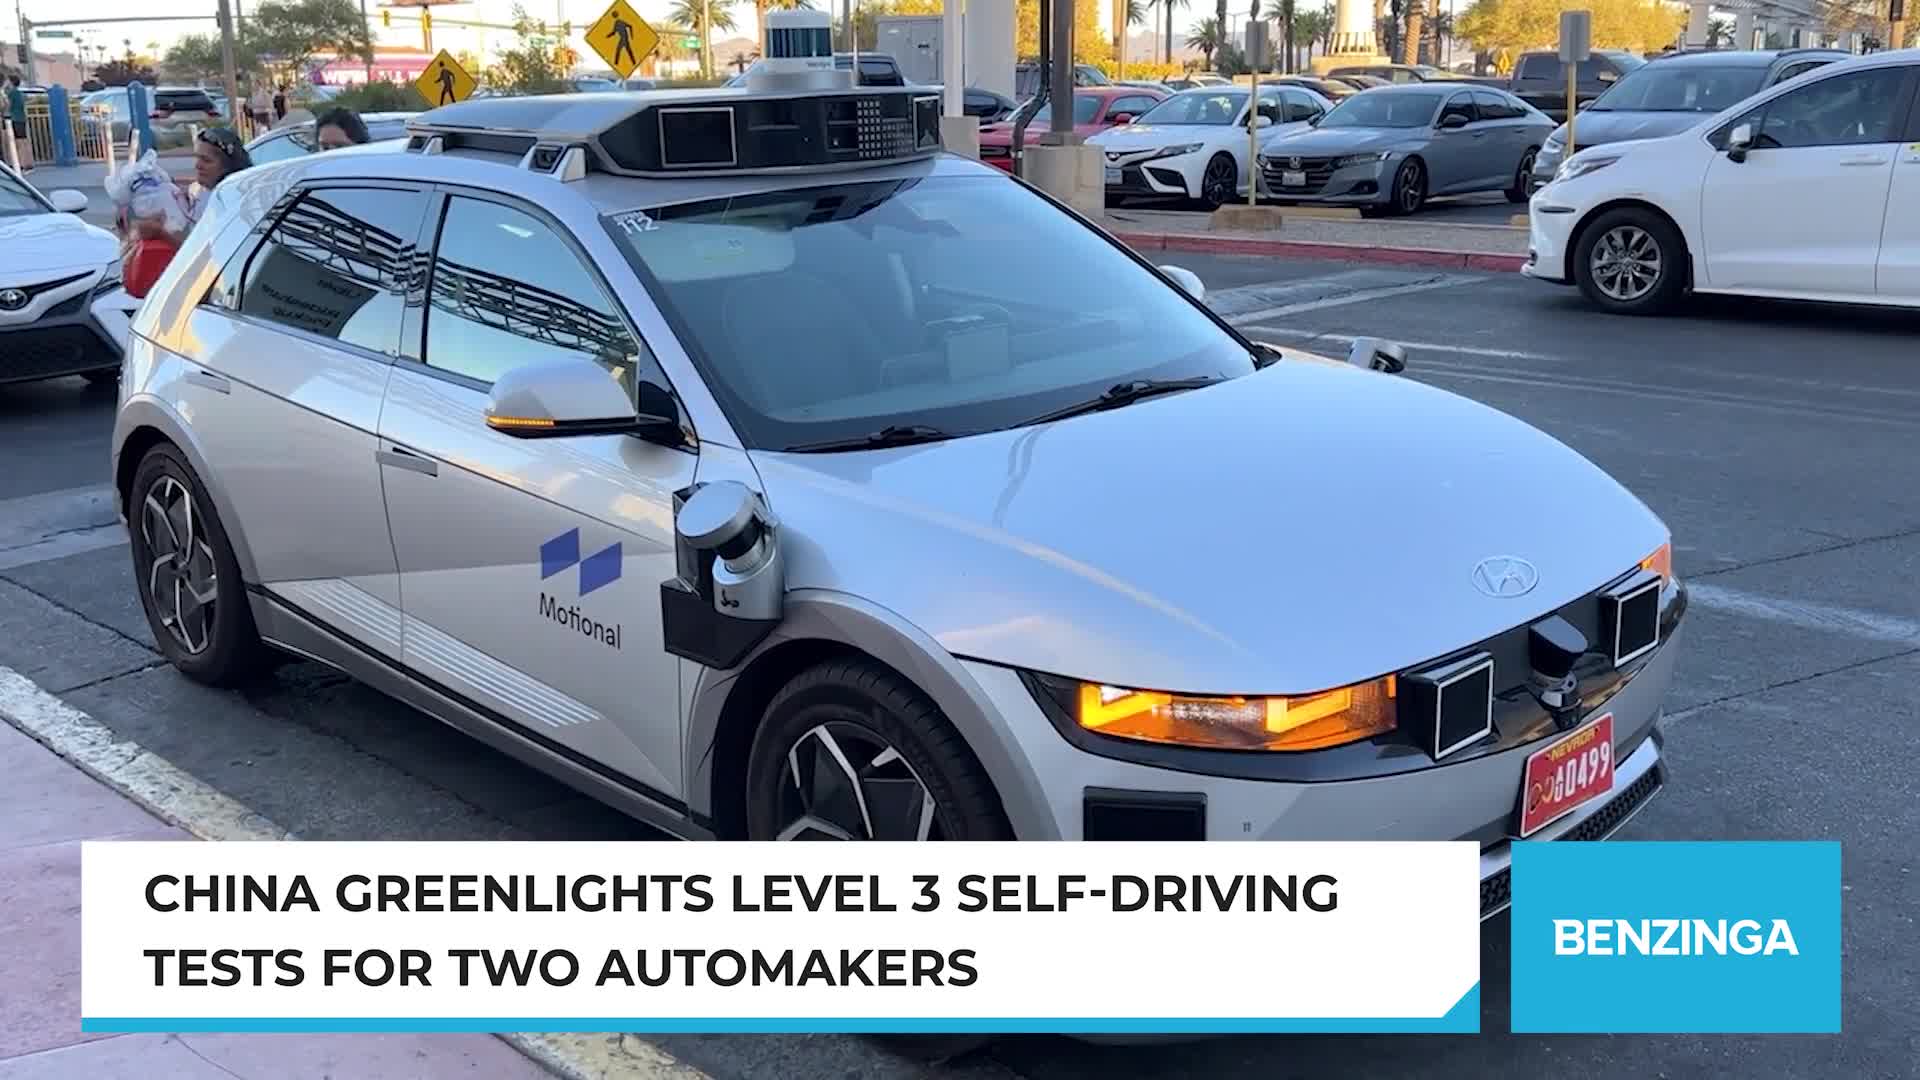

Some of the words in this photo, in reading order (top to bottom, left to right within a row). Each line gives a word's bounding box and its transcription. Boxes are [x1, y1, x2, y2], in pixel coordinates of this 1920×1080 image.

[617, 215, 660, 234] 112
[539, 592, 622, 650] Motional
[1551, 728, 1596, 762] NEVADA
